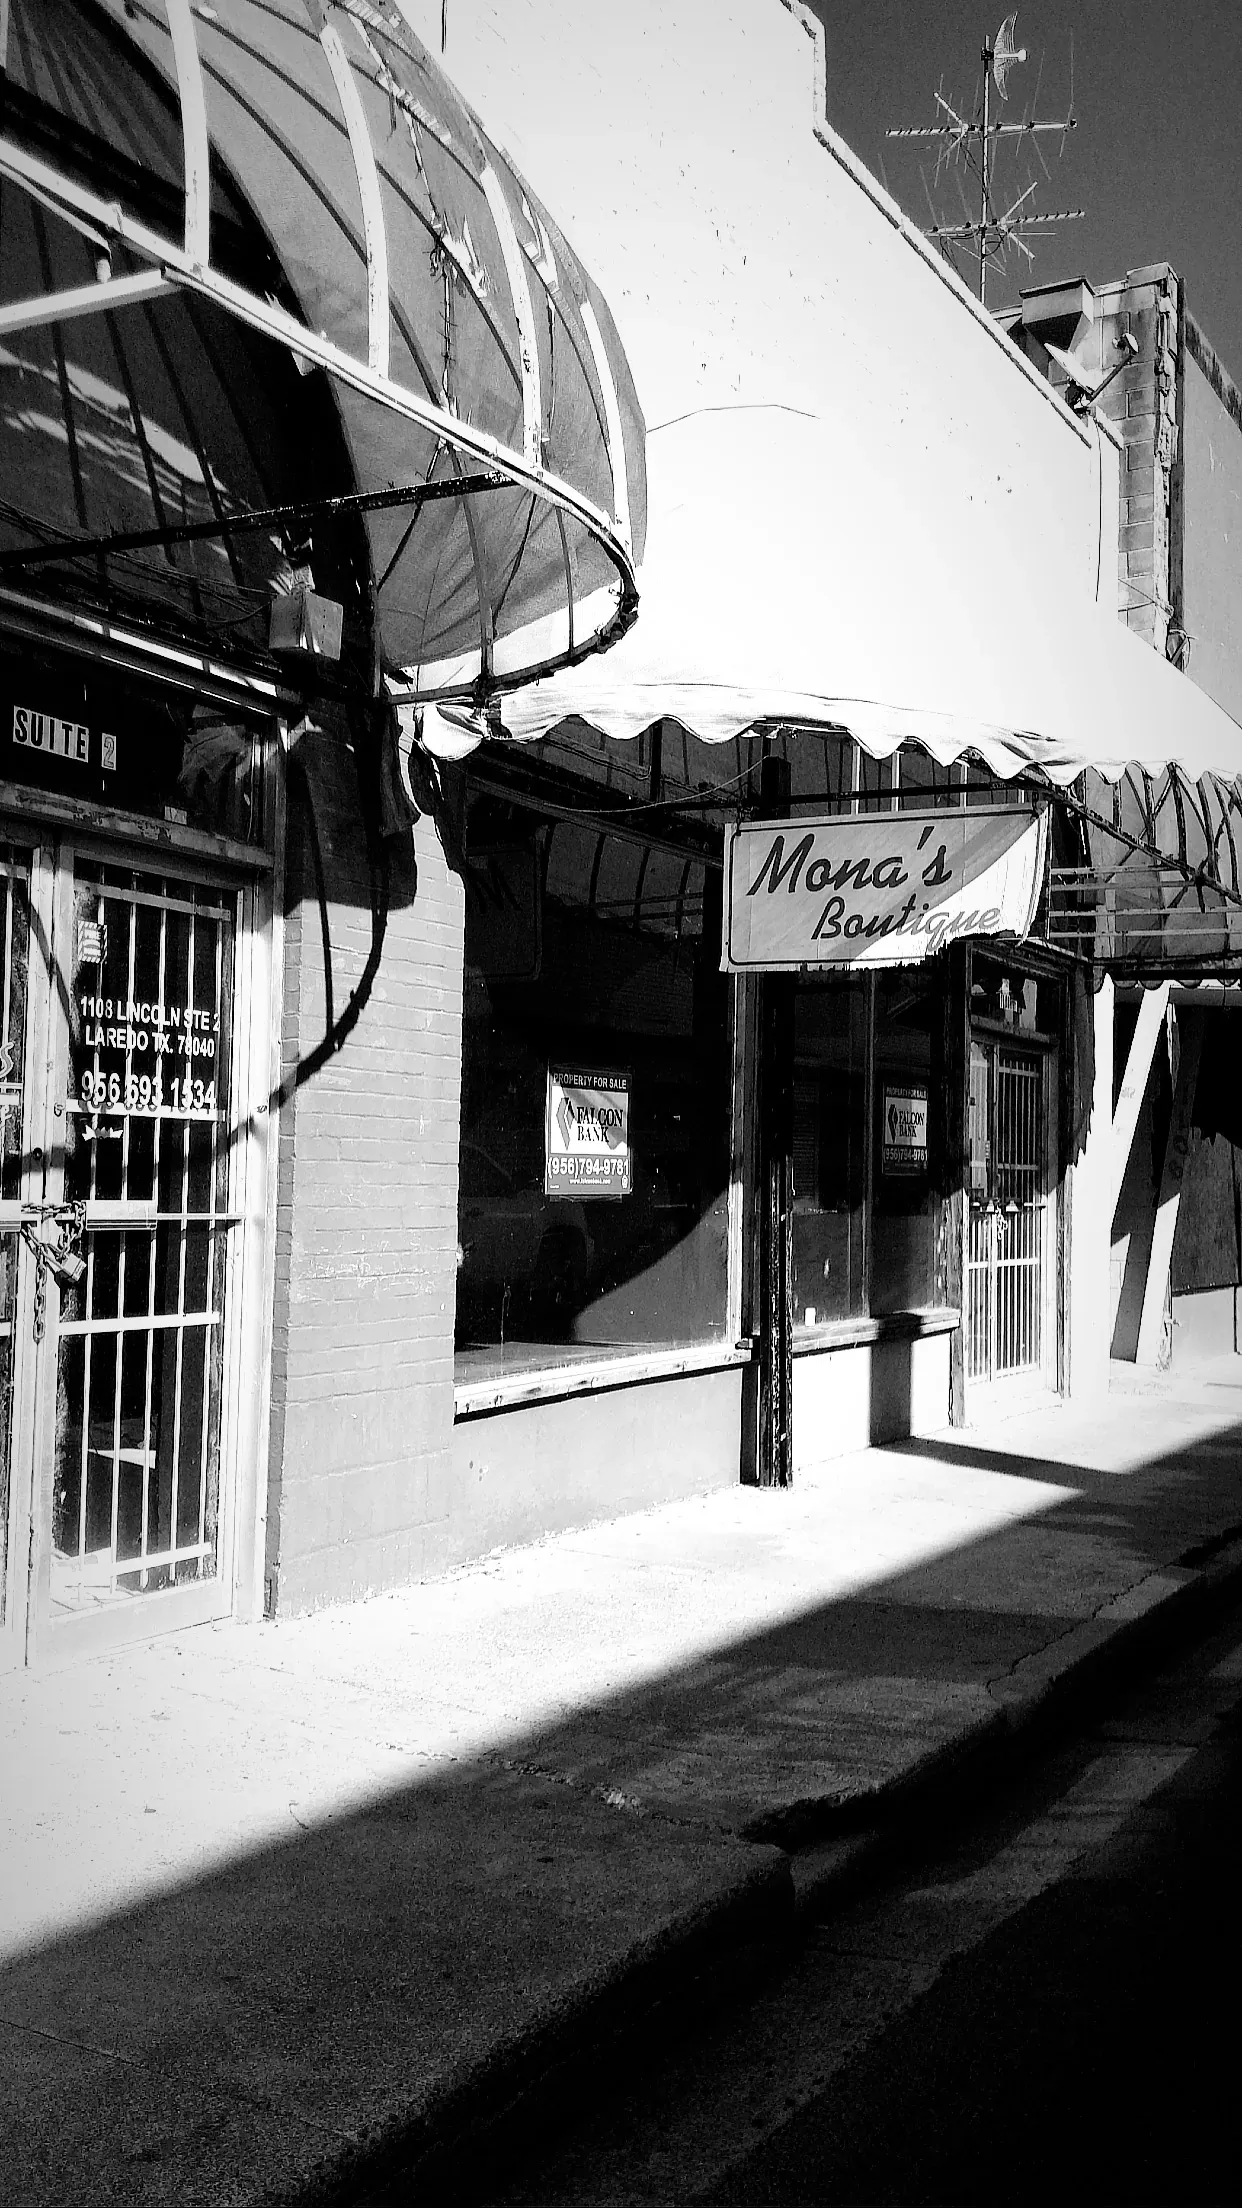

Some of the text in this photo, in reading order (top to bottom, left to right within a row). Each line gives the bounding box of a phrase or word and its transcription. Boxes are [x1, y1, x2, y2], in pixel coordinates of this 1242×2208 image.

[14, 708, 115, 769] SUITE 2
[746, 826, 952, 896] Mona's
[811, 893, 1001, 951] Boutique
[81, 995, 220, 1032] 1108 LINCOLN STE 2
[86, 1024, 149, 1051] LAREDO
[178, 1035, 215, 1058] 78040
[82, 1070, 217, 1110] 956 693 1534
[553, 1073, 627, 1090] PROPERTY FOR SALE
[577, 1106, 623, 1127] FALCON
[577, 1125, 609, 1142] BANK
[899, 1110, 924, 1126] FALCON
[547, 1157, 629, 1180] (956)794-9781
